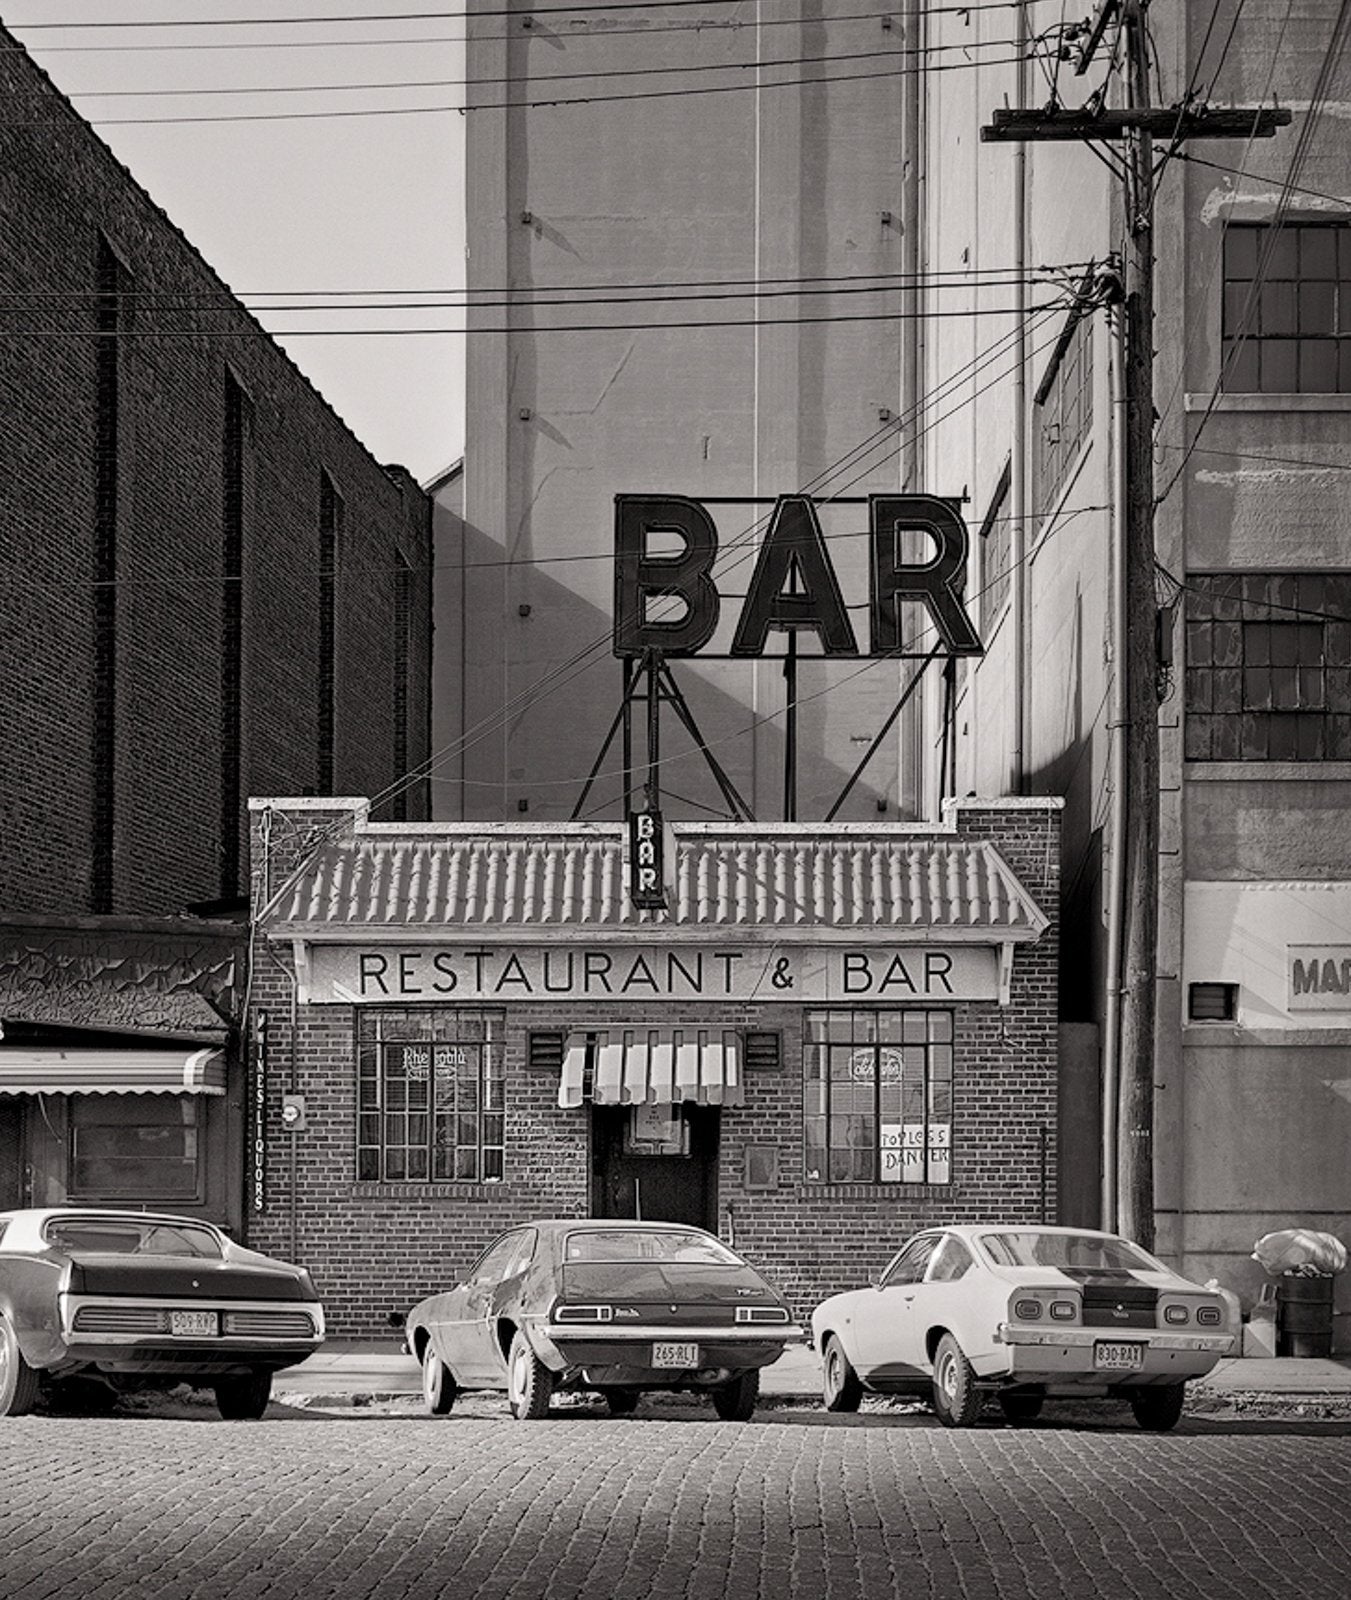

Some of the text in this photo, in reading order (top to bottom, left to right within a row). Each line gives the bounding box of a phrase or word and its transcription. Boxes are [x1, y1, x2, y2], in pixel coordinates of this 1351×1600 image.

[614, 493, 984, 657] BAR
[637, 813, 656, 892] BAR
[359, 951, 954, 995] RESTAURANT & BAR
[402, 1046, 467, 1069] Rhegold
[255, 1110, 264, 1211] LIQUORS
